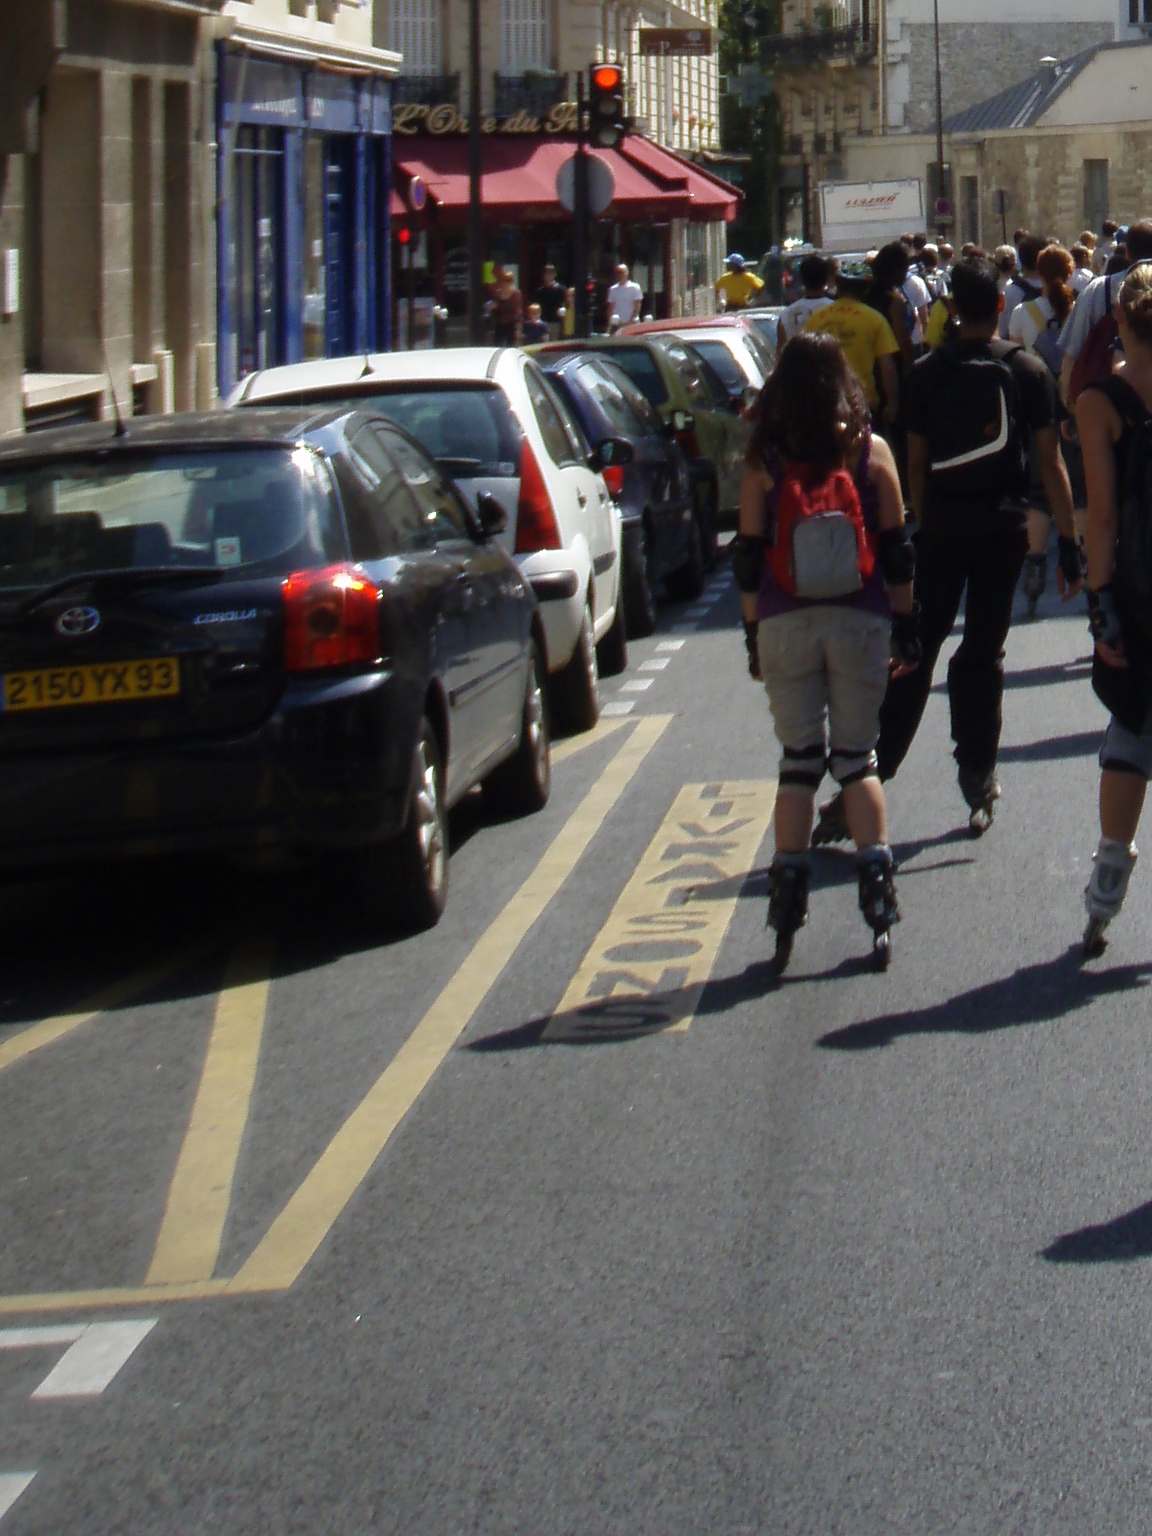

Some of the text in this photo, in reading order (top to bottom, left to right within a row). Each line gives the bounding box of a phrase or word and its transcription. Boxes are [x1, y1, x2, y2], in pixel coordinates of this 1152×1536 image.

[392, 102, 498, 135] L'Ore
[501, 109, 541, 133] du
[193, 608, 257, 625] COROLLA
[9, 661, 175, 705] 2150 YX 93
